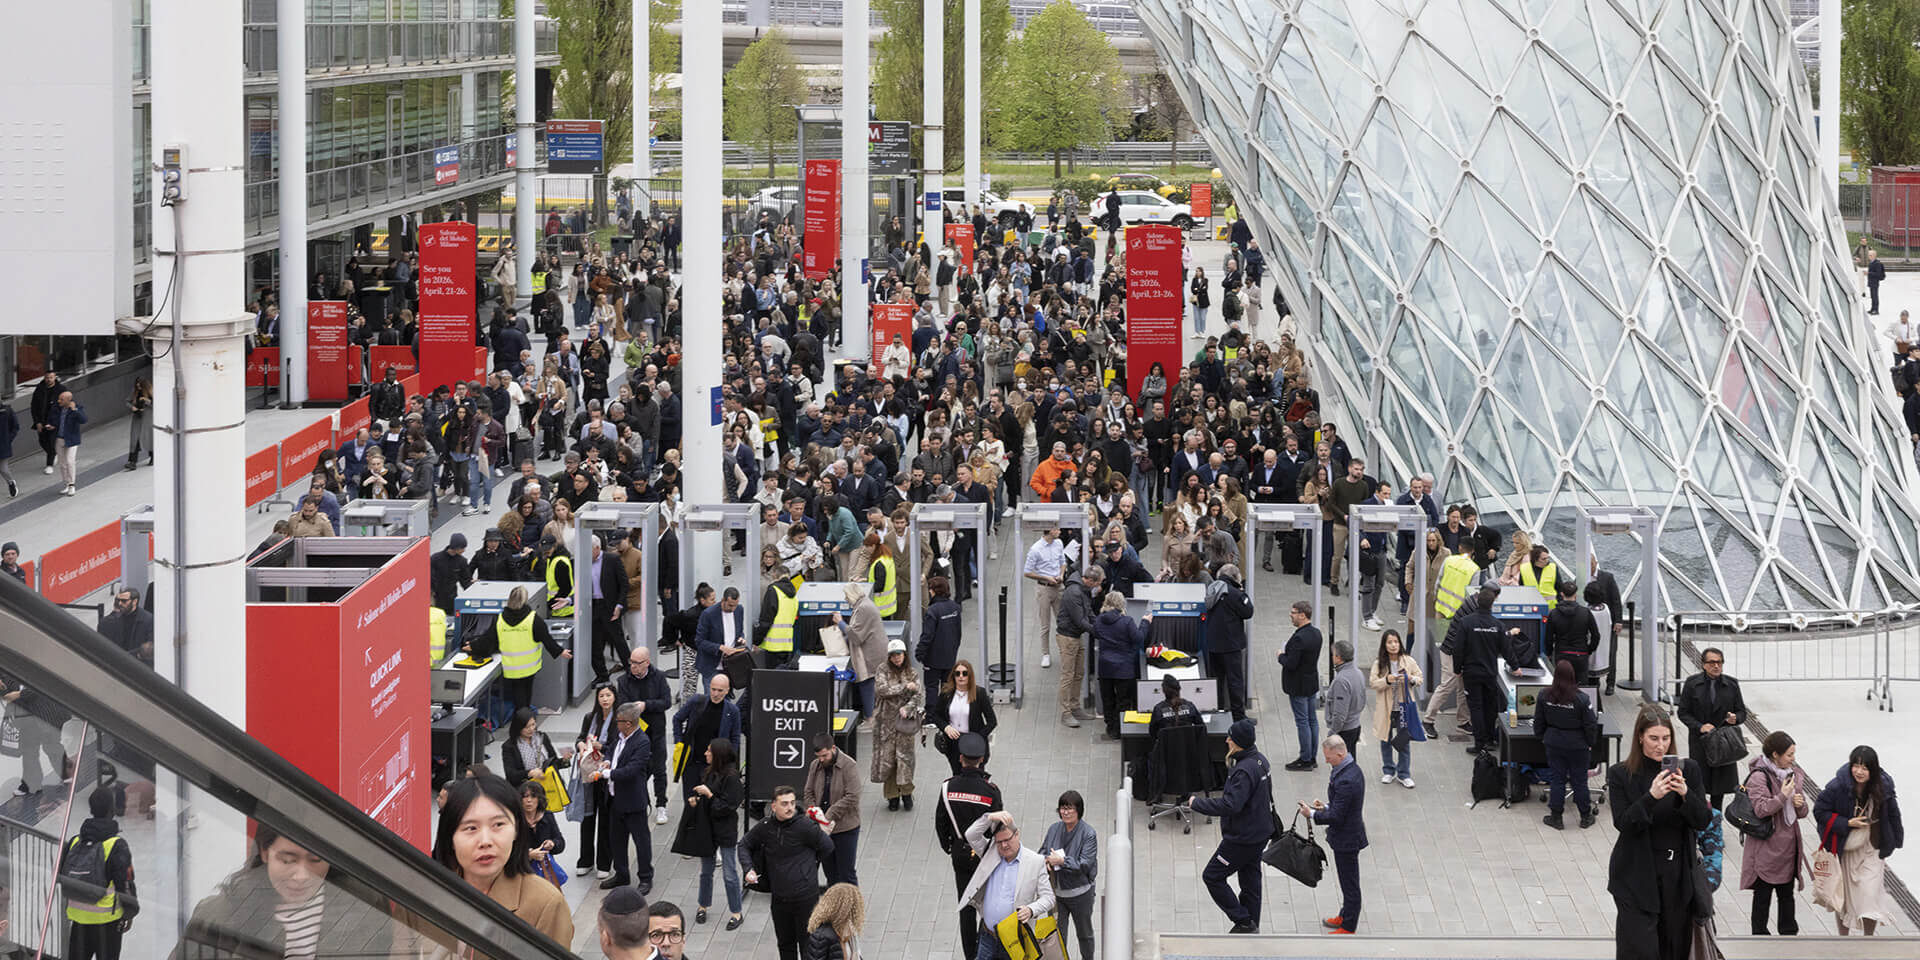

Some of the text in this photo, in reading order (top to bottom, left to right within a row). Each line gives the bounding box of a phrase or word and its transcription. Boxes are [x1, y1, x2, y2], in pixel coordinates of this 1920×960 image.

[868, 128, 881, 140] M
[423, 265, 452, 275] See you
[1130, 267, 1159, 278] See you
[423, 276, 431, 284] in
[1130, 279, 1139, 287] in
[58, 567, 79, 586] Salone
[79, 559, 89, 576] del
[364, 607, 380, 627] Salone
[379, 596, 387, 615] del
[370, 647, 402, 689] QUICK LINK
[762, 698, 819, 713] USCITA
[775, 717, 805, 731] EXIT
